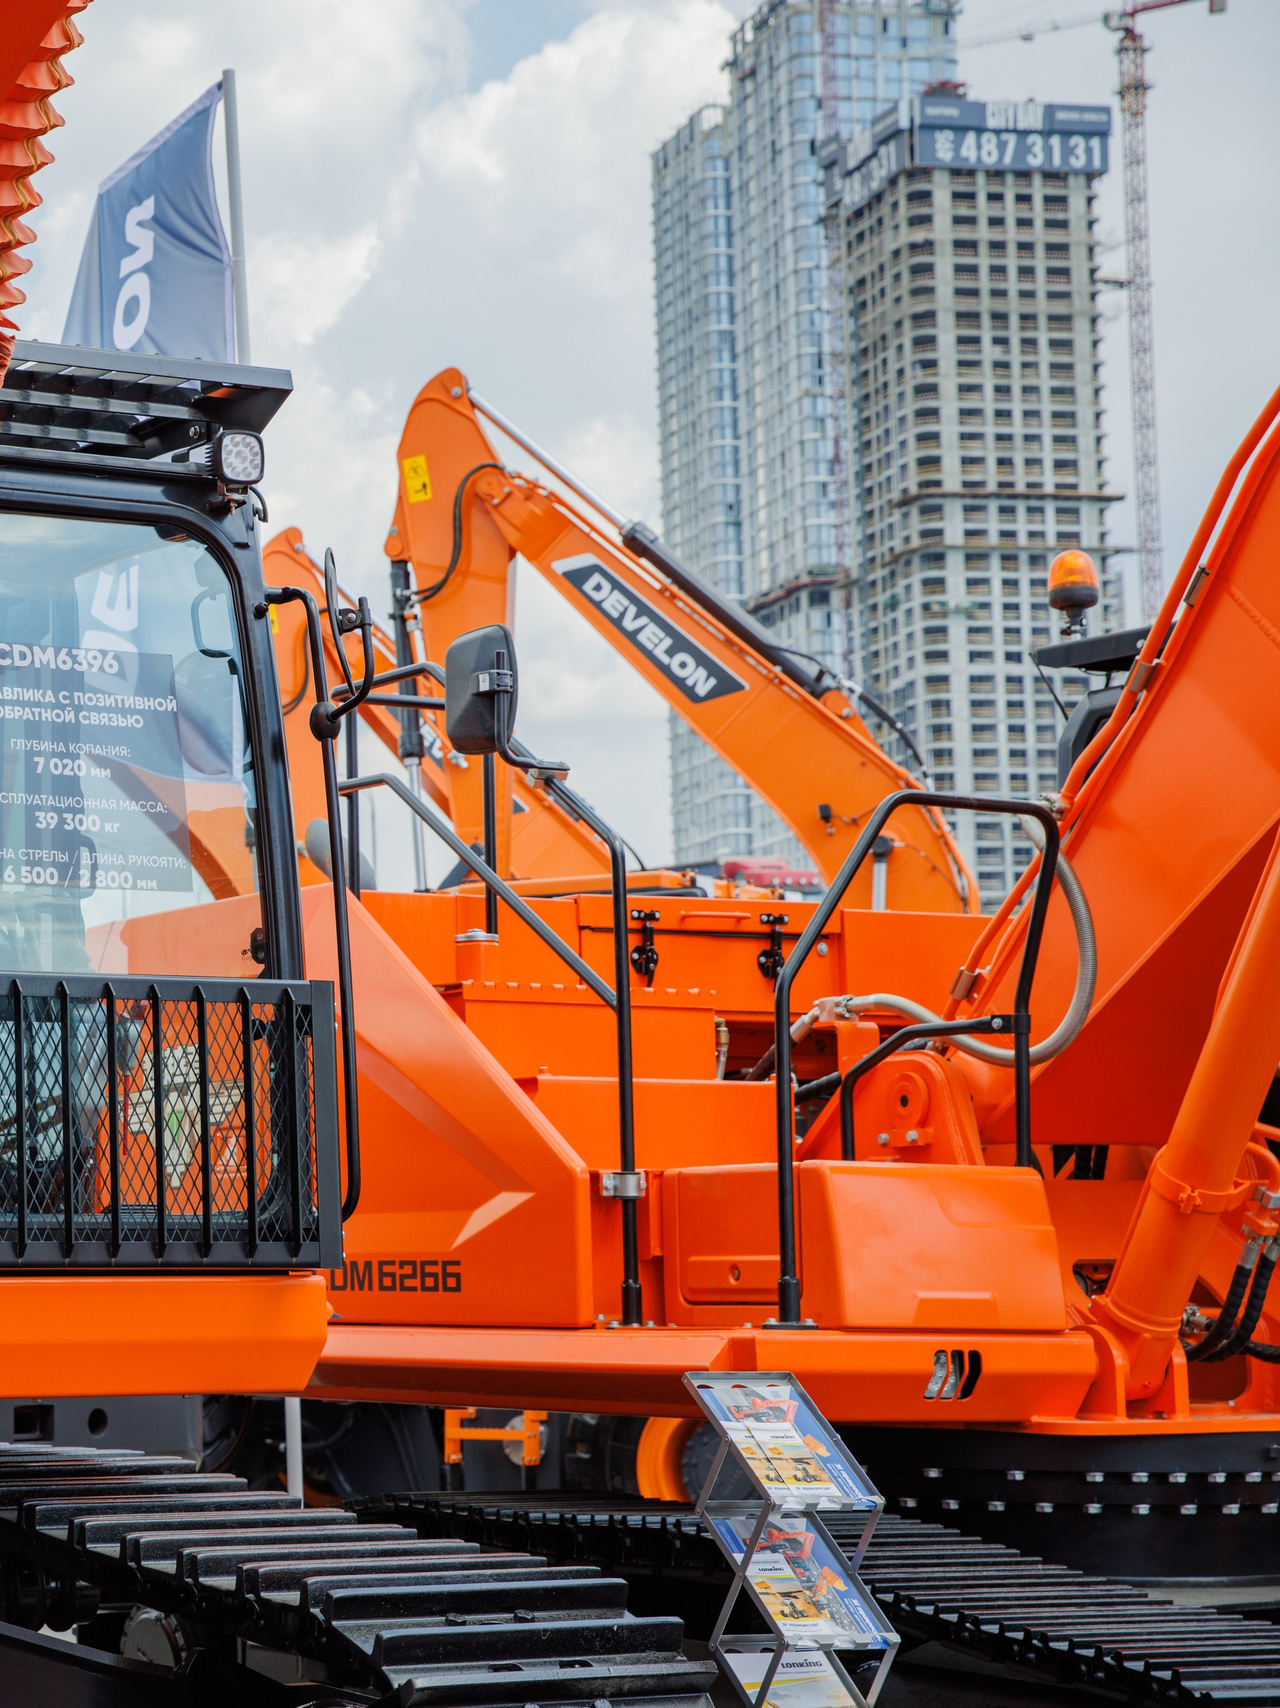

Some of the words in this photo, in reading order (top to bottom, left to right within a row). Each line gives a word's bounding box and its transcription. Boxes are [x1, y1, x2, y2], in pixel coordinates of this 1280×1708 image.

[959, 130, 1018, 166] 487
[582, 572, 718, 698] DEVELON
[59, 691, 70, 704] С
[73, 691, 177, 712] ПОЗИТИВНОЙ
[78, 711, 144, 728] СВЯЗЬЮ
[10, 738, 66, 754] ГЛУБИНА
[68, 743, 131, 757] КОПАНИЯ:
[33, 757, 44, 774] 7
[50, 758, 87, 776] 020
[120, 801, 168, 813] МАССА:
[35, 811, 59, 830] 39
[63, 813, 101, 832] 300
[104, 822, 120, 833] кг
[18, 849, 69, 863] СТРЕЛЫ
[82, 852, 125, 867] ДЛИНА
[128, 855, 187, 869] РУКОЯТИ:
[3, 865, 16, 883] 6
[20, 866, 59, 885] 500
[94, 870, 133, 889] 800
[312, 1260, 462, 1292] DM6266
